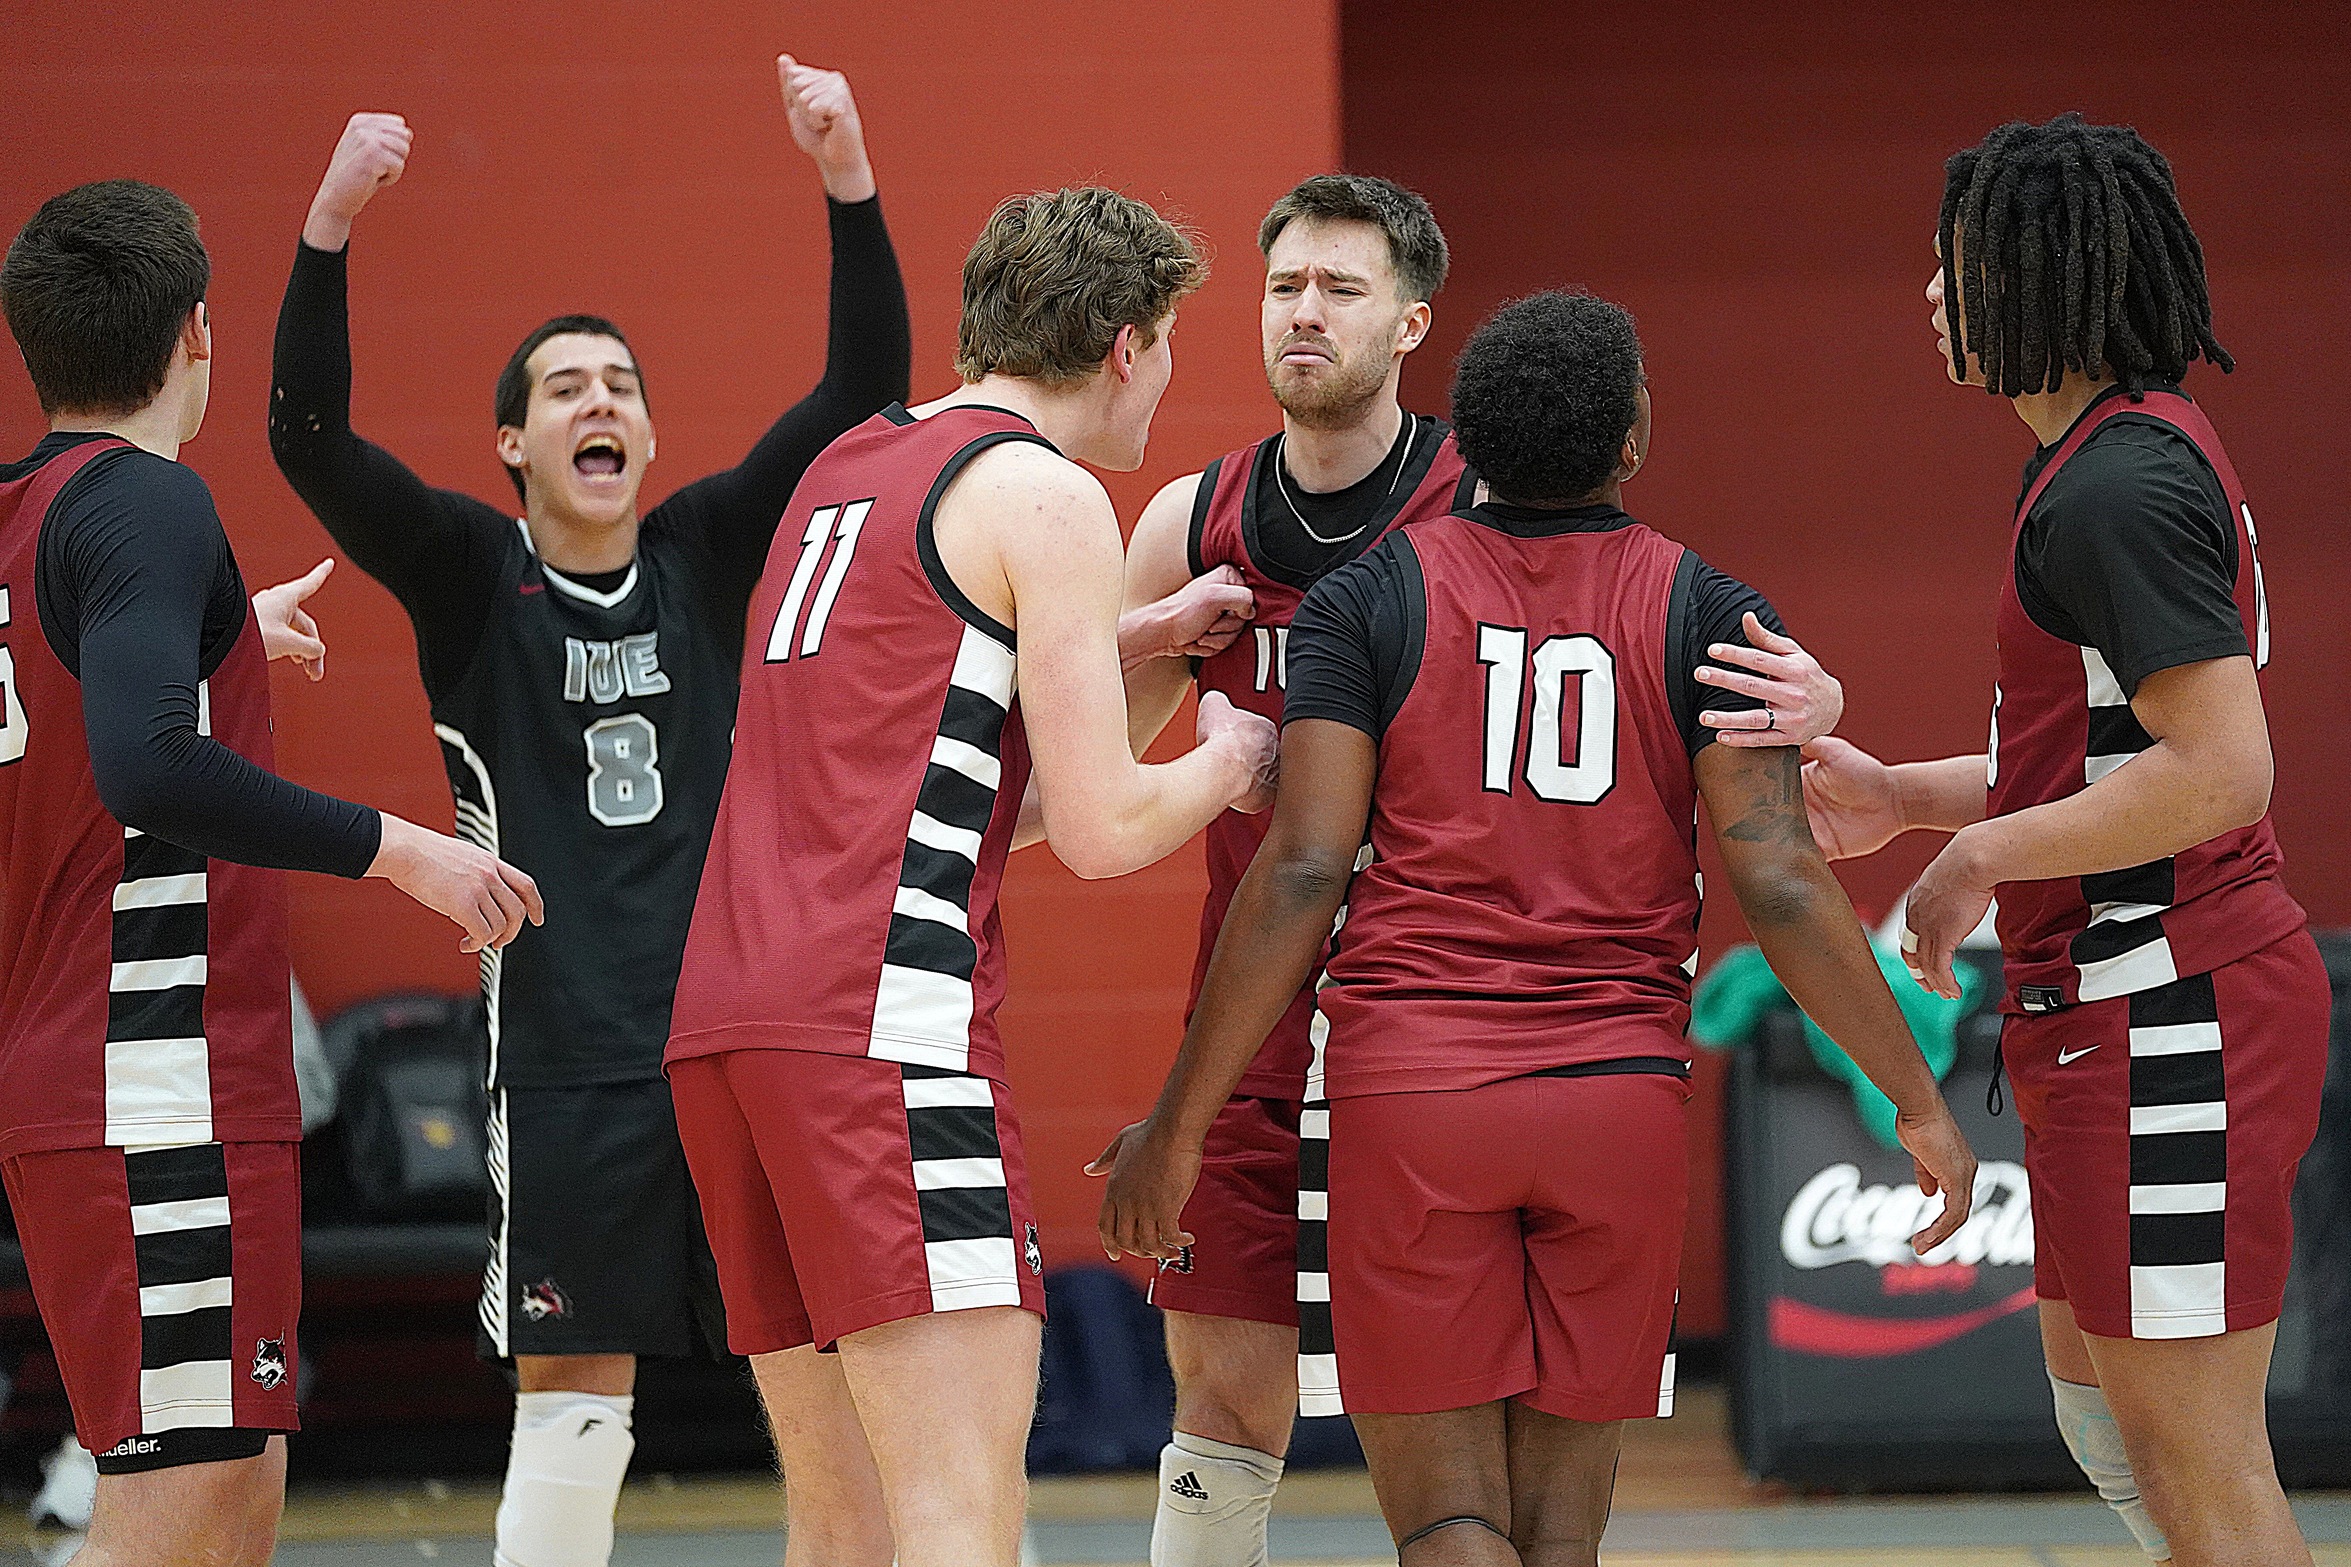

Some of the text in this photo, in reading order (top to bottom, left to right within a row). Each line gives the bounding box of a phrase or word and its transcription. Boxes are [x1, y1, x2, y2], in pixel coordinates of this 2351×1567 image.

[762, 496, 878, 666] 11
[563, 630, 672, 705] IUE
[1476, 620, 1619, 807] 10
[583, 712, 664, 828] 8
[1780, 1160, 2036, 1271] Cocaol
[97, 1437, 163, 1458] ueller.
[1170, 1484, 1209, 1500] adidas
